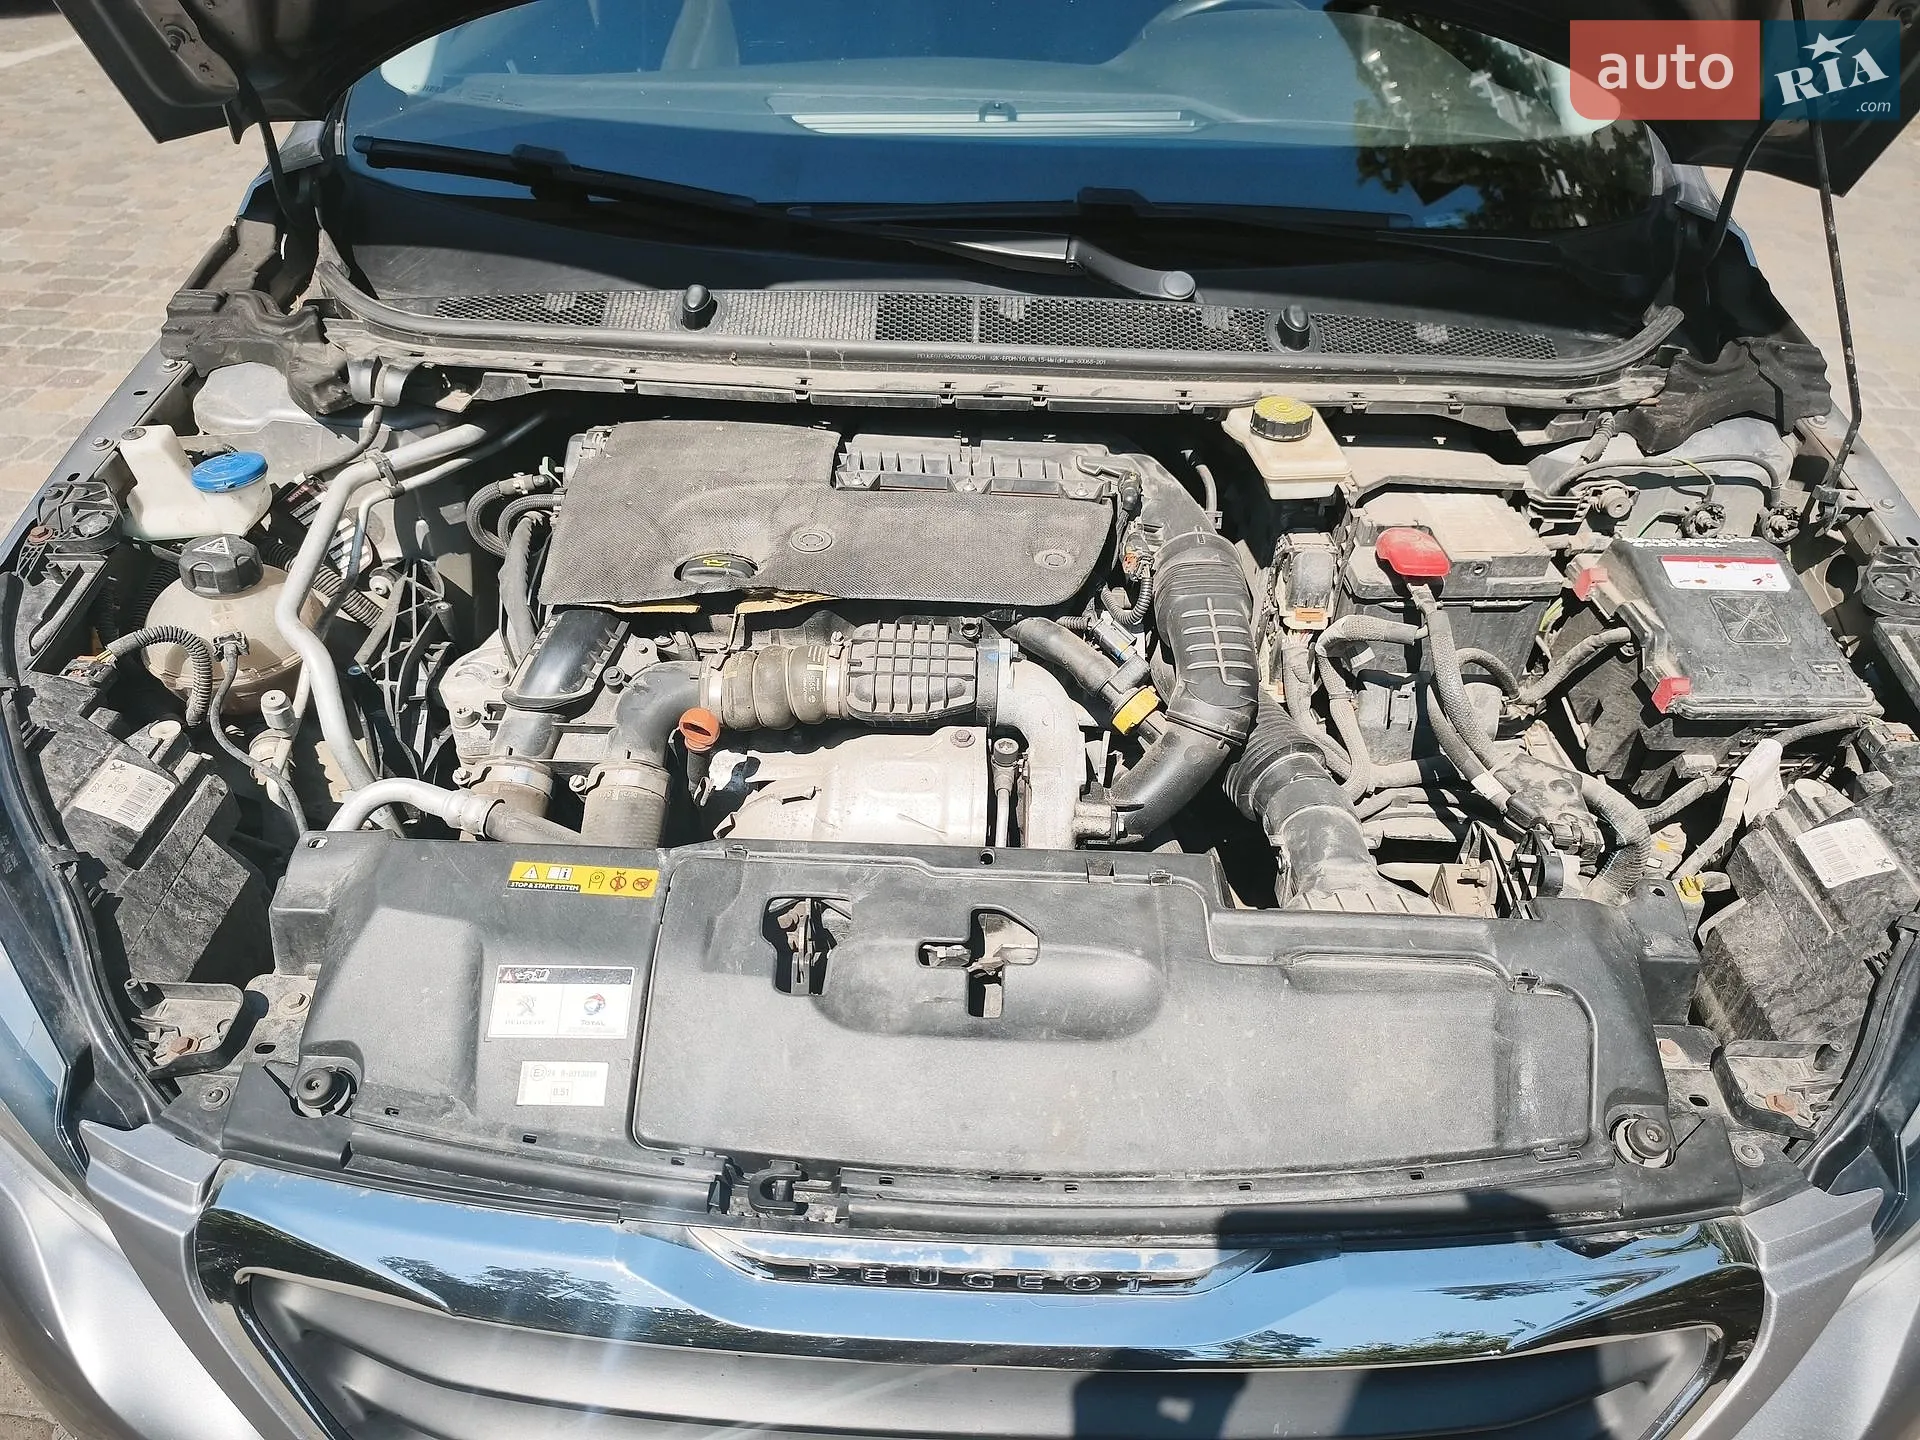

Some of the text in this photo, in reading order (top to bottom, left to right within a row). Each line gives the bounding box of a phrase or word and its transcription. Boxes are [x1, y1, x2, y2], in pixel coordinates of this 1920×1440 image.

[287, 485, 309, 502] MOTUL
[510, 881, 528, 889] STOP
[807, 1261, 1152, 1293] PEUGEOT
